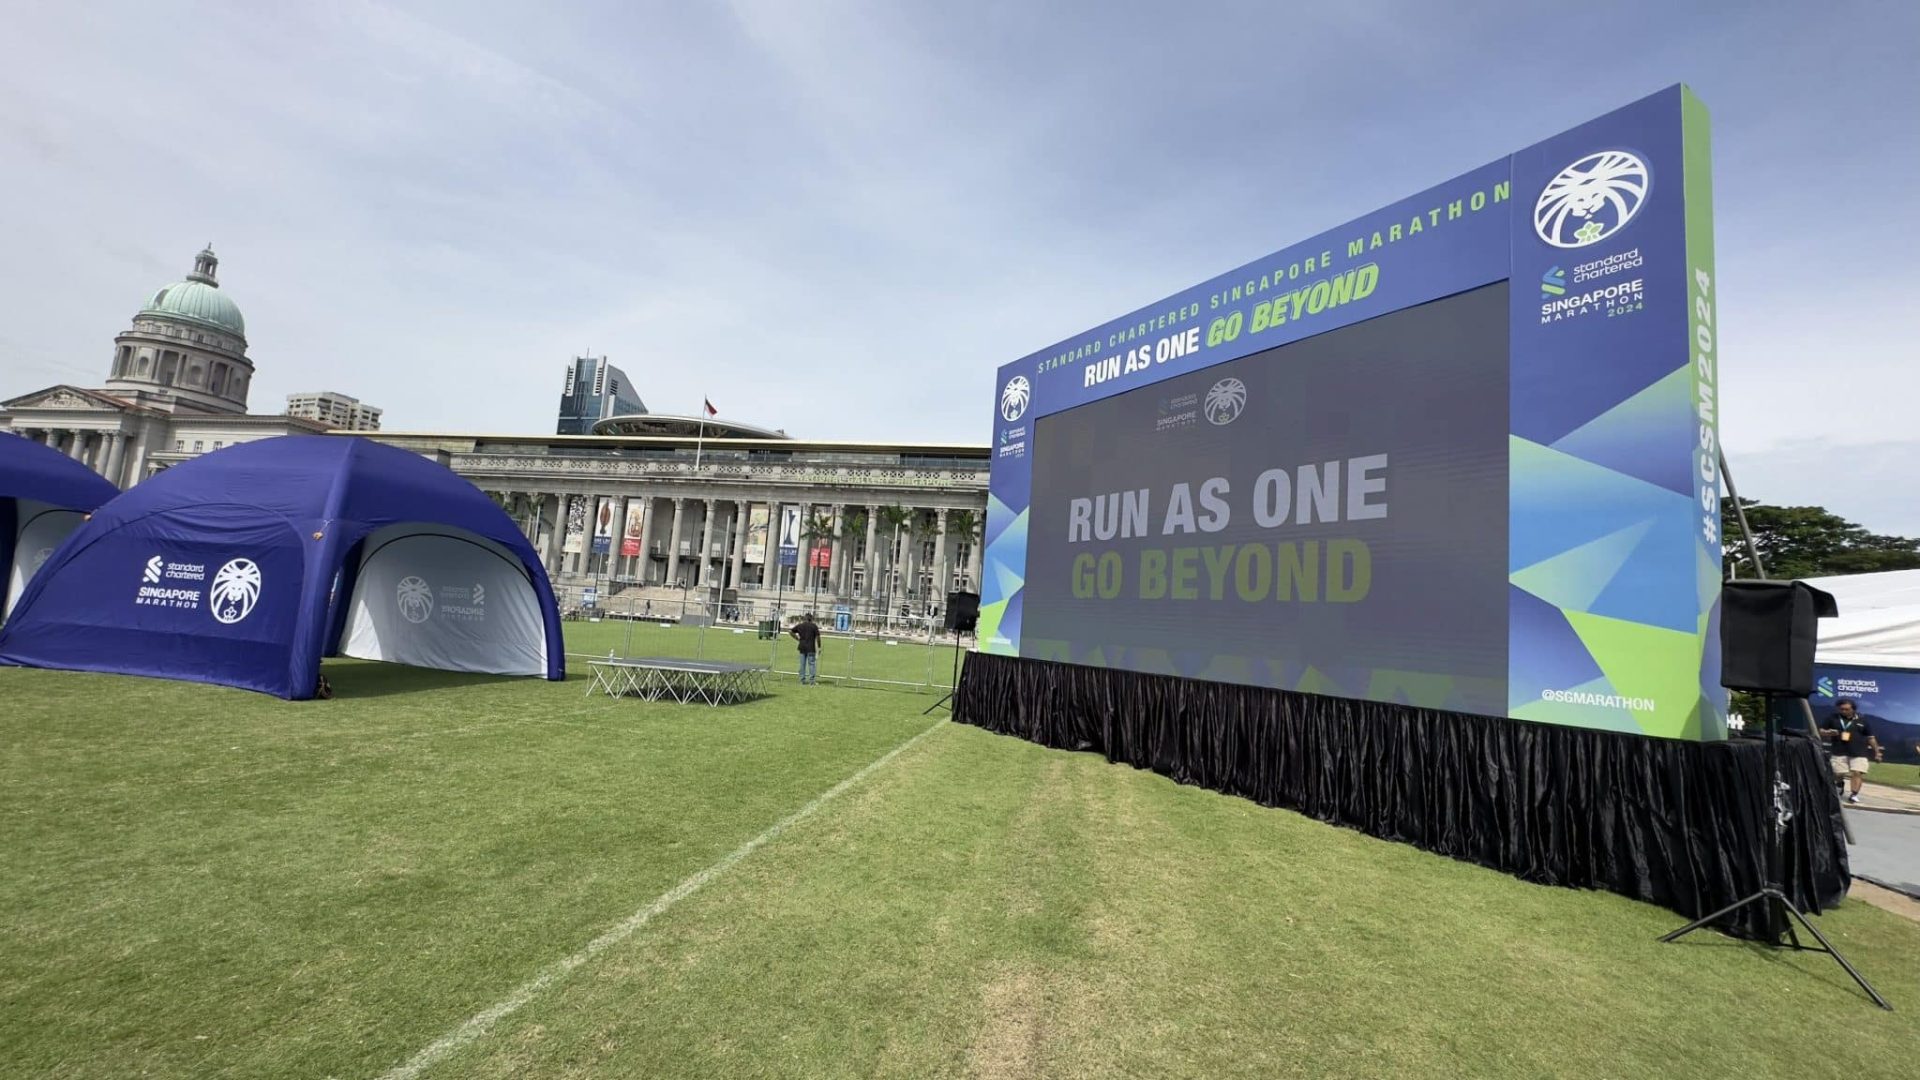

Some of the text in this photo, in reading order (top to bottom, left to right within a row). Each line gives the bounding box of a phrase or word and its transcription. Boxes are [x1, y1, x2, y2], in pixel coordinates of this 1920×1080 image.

[1573, 248, 1639, 275] standard
[1573, 256, 1643, 283] chartered
[1038, 180, 1511, 374] STANDARD CHARTERED SINGAPORE MARATHON
[1541, 279, 1643, 315] SINGAPORE
[1541, 292, 1643, 325] MARATHON
[1608, 303, 1643, 317] 2024
[1084, 263, 1379, 388] RUN AS ONE GO BEYOND
[1695, 268, 1717, 545] #SCSM2024
[1068, 453, 1388, 543] RUN AS ONE
[165, 570, 205, 580] chartered
[168, 562, 205, 573] standard
[1071, 538, 1373, 604] GO BEYOND
[136, 597, 198, 609] MARATHON
[139, 586, 201, 601] SINGAPORE
[1837, 678, 1876, 687] standard
[1837, 685, 1879, 693] chartered
[1542, 689, 1655, 712] @SGMARATHON
